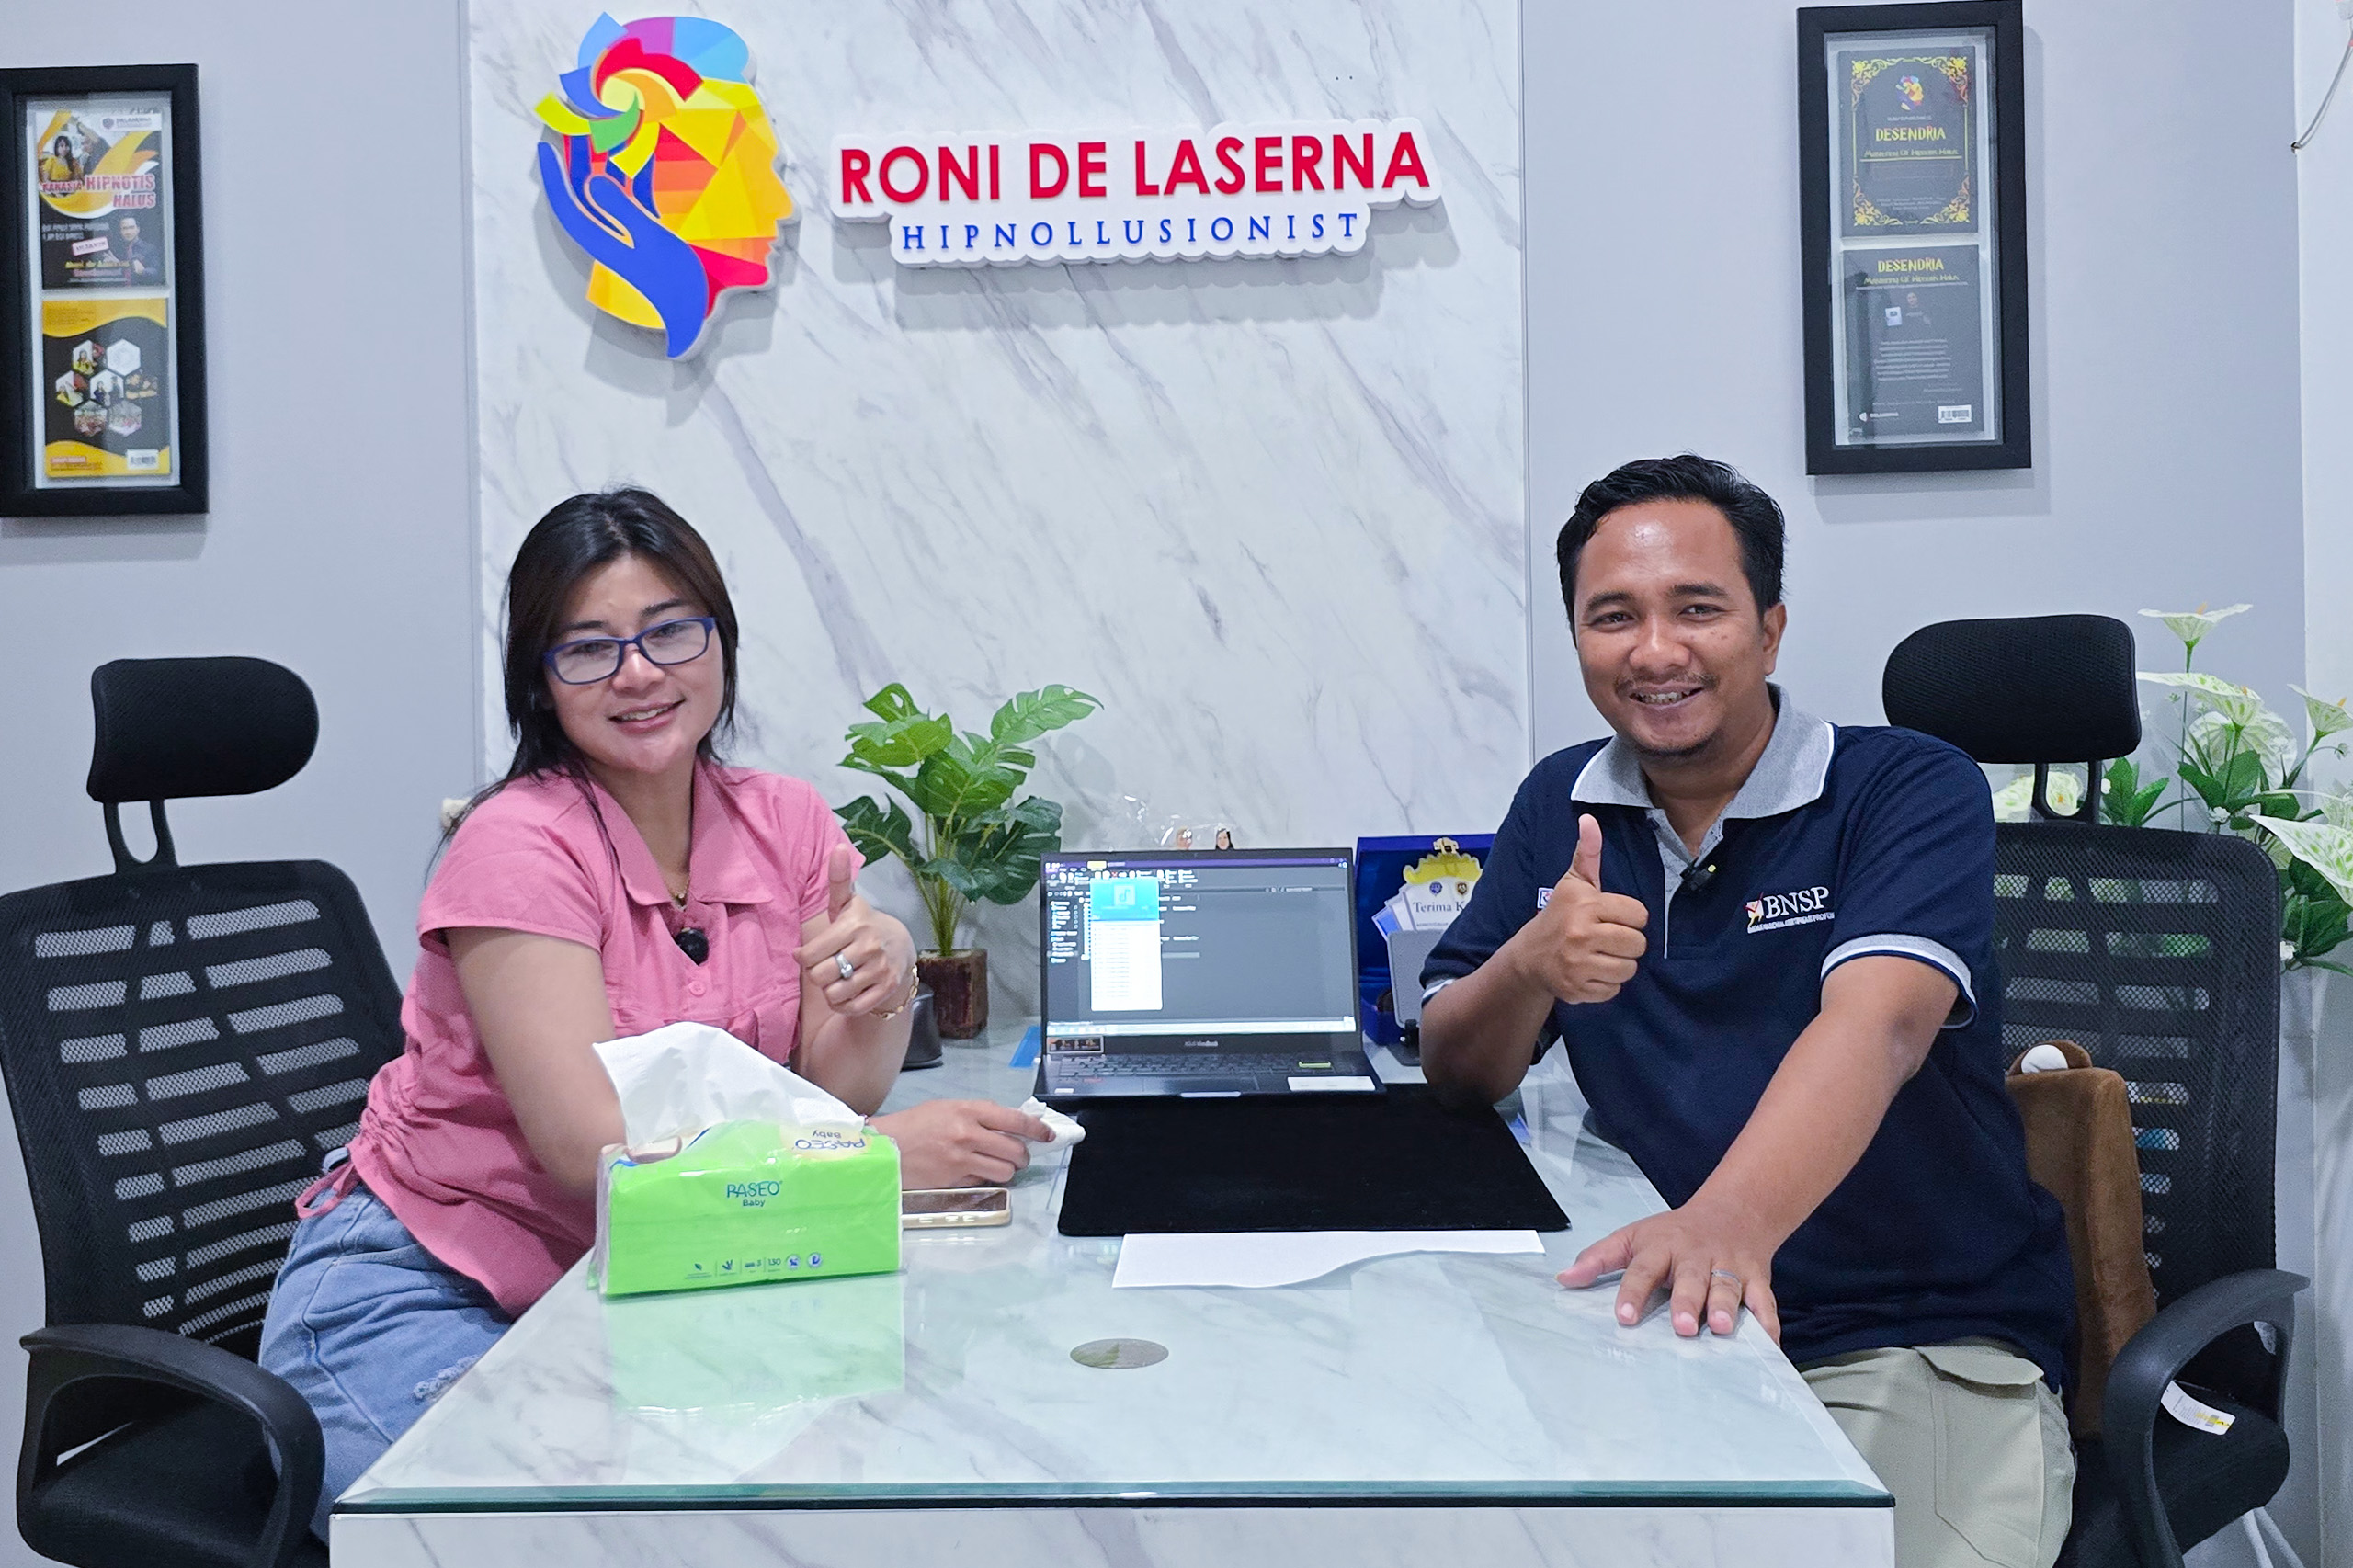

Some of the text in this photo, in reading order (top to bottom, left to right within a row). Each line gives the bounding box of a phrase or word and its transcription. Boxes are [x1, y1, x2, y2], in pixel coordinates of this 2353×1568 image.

[1875, 125, 1946, 142] DESENDRIA
[840, 131, 1430, 204] RONI DE LASERNA
[85, 174, 154, 191] HIPNOTIS
[113, 193, 154, 208] HALUS
[902, 212, 1358, 249] HIPNOLLUSIONIST
[1877, 256, 1945, 273] DESENDRIA
[1414, 901, 1452, 913] Terima
[1763, 886, 1829, 919] BNSP
[727, 1180, 779, 1199] PASEO
[743, 1199, 766, 1207] Baby
